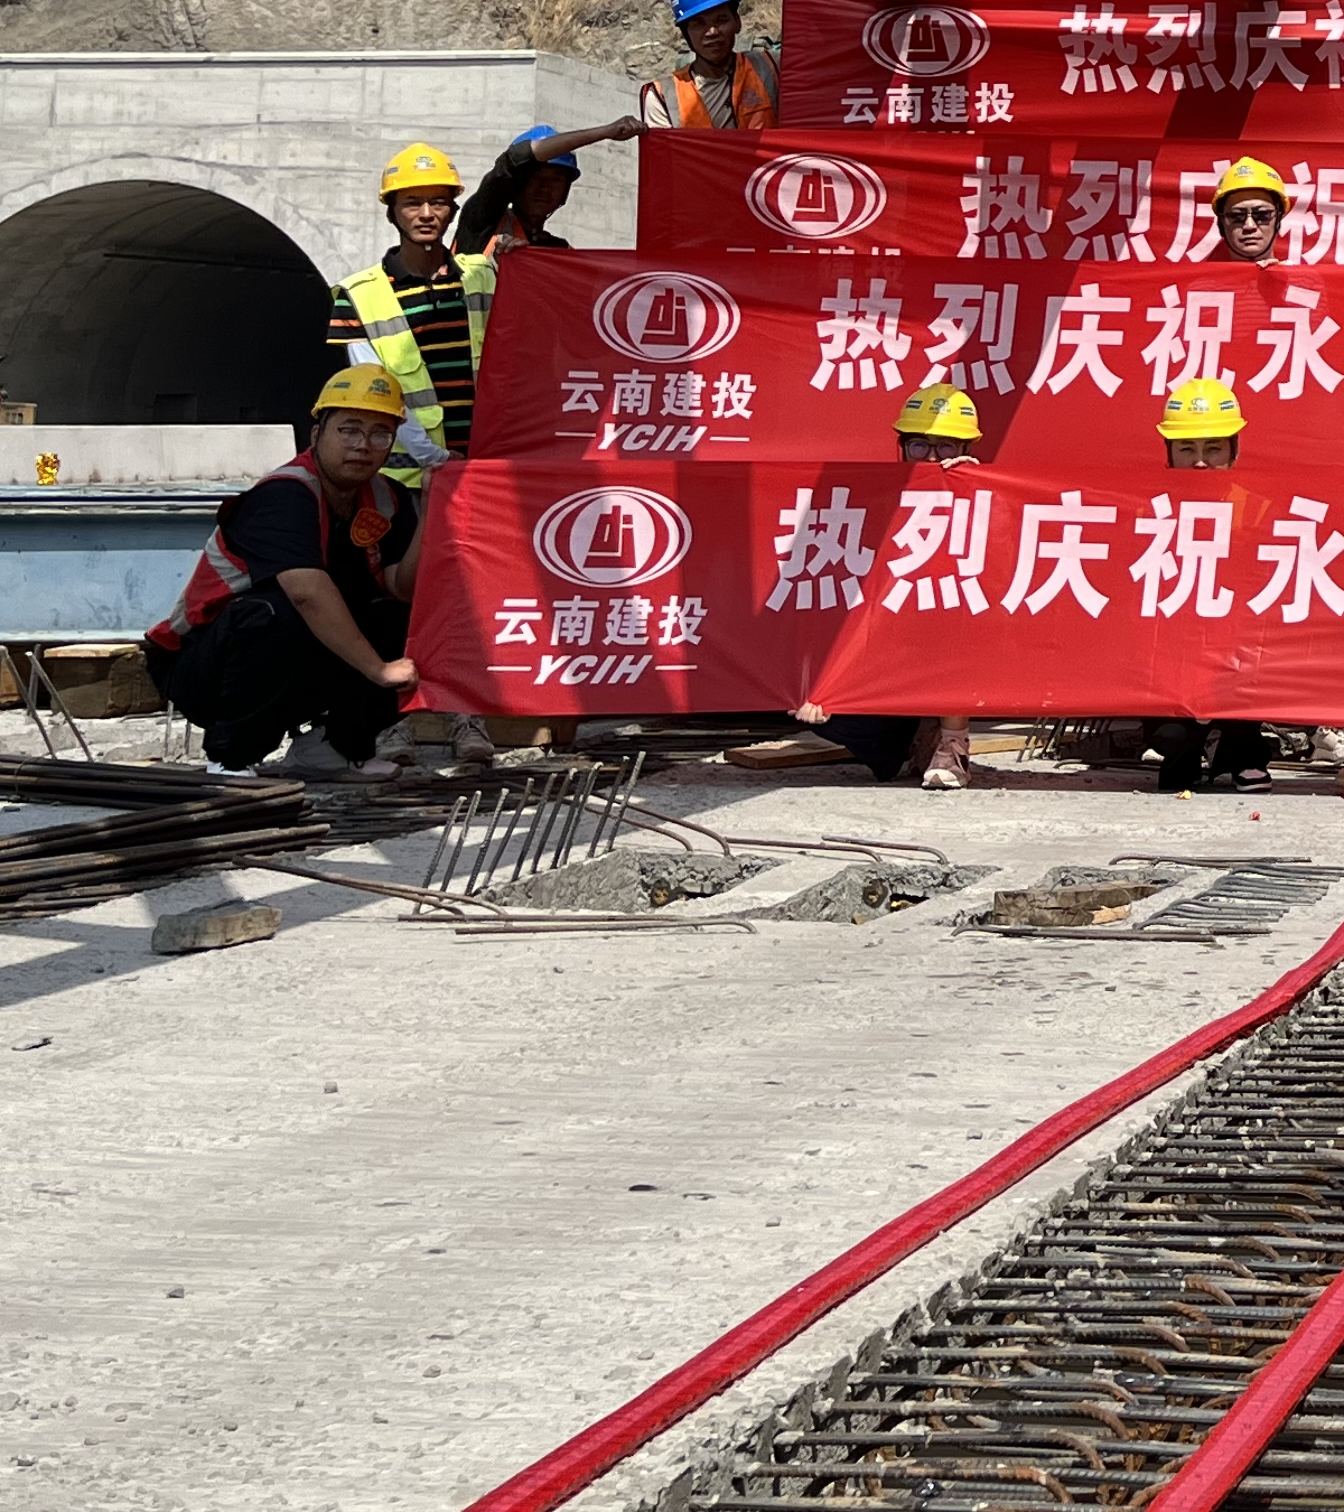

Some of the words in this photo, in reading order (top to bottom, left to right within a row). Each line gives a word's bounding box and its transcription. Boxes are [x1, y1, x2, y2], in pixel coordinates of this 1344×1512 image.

[841, 83, 1015, 124] 云南建投
[560, 369, 757, 420] 云南建投
[597, 423, 708, 452] YCIH
[494, 595, 708, 647] 云南建投
[533, 654, 654, 686] YCIH
